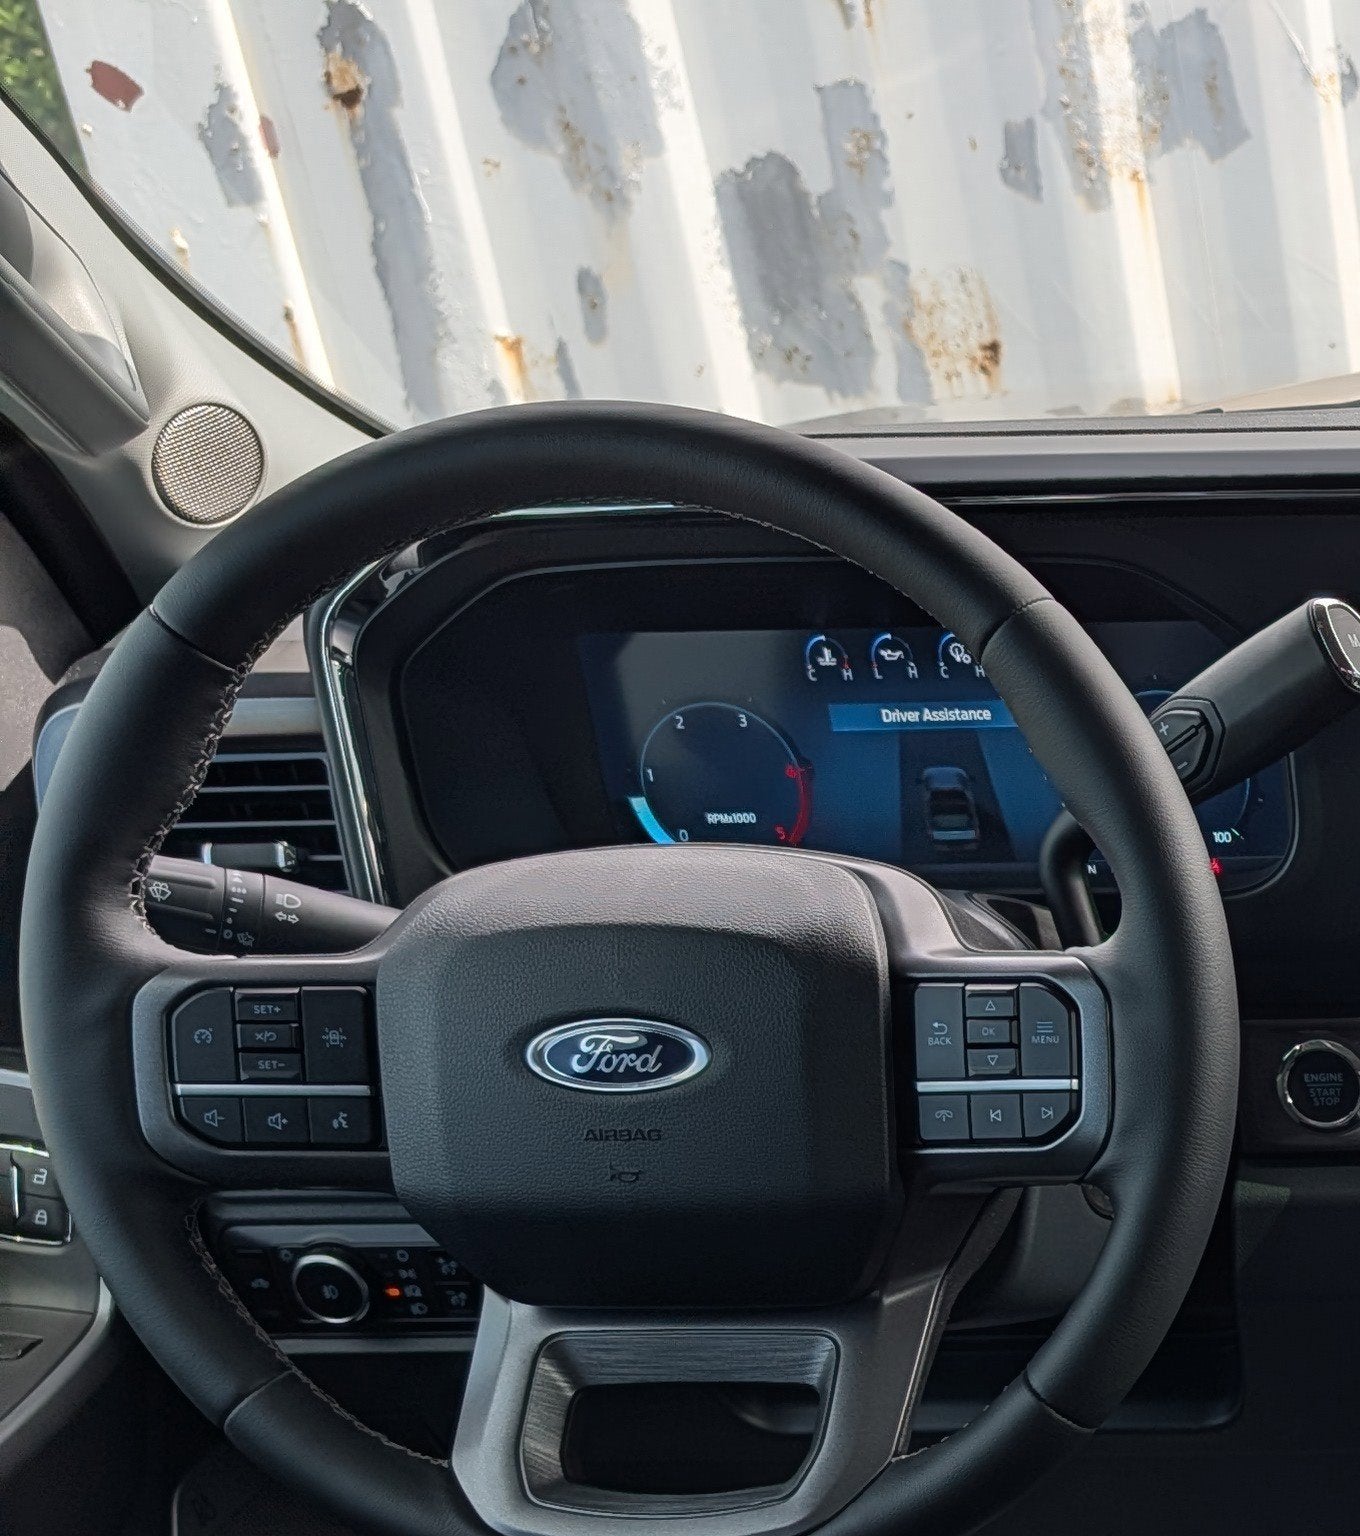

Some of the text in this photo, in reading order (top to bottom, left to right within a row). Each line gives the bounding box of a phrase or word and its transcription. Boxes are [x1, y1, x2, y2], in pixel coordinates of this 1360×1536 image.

[738, 714, 748, 728] 3
[881, 708, 992, 723] Driver Assistance
[675, 715, 685, 730] 2
[647, 768, 654, 782] 1
[706, 812, 757, 824] RPMx1000
[679, 829, 689, 842] 0
[1212, 831, 1232, 843] 100
[254, 1004, 281, 1014] SET+
[981, 1027, 995, 1036] OK
[928, 1037, 952, 1046] BACK
[1031, 1036, 1060, 1044] MENU
[569, 1033, 662, 1075] Ford
[1304, 1072, 1343, 1083] ENGINE
[1309, 1088, 1341, 1097] START
[1313, 1097, 1340, 1106] STOP
[584, 1129, 662, 1142] AIRBAG
